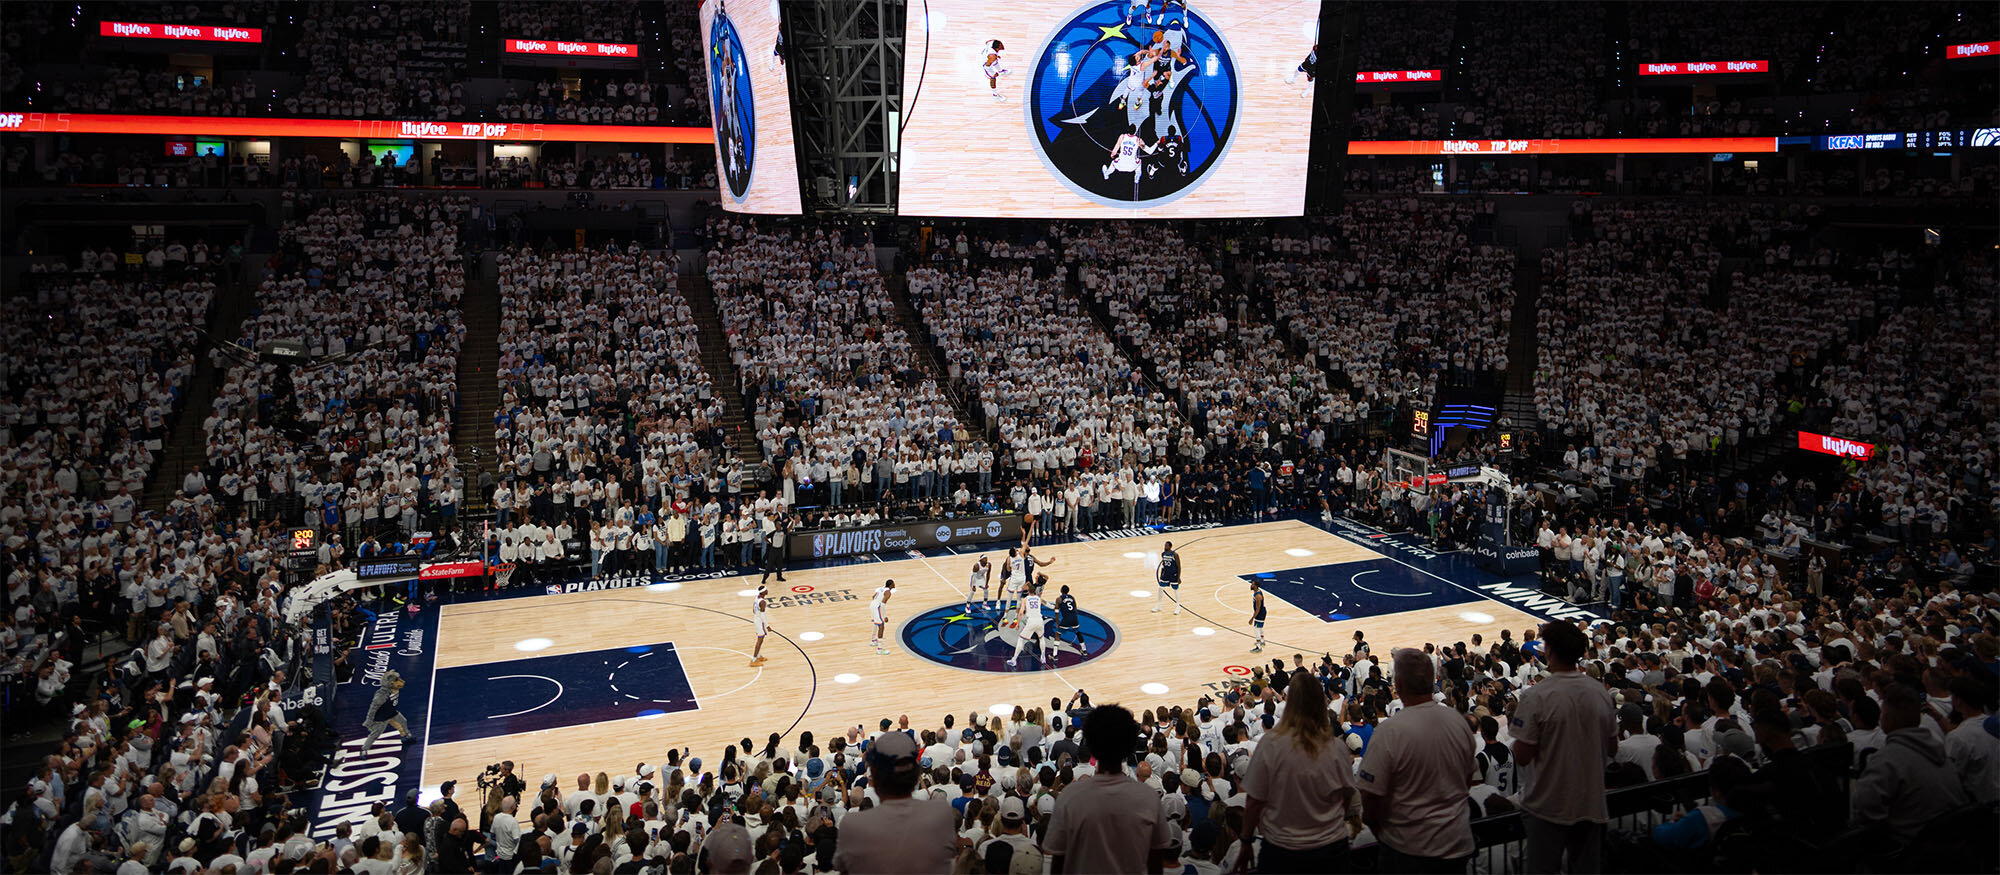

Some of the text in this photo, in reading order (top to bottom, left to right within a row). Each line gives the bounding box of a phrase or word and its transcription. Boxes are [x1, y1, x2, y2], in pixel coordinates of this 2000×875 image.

[462, 124, 480, 136] TIP
[486, 124, 507, 136] OFF
[1490, 141, 1507, 151] TIP
[1511, 141, 1528, 151] OFF
[1828, 135, 1864, 149] KFAN
[1122, 145, 1133, 156] 55
[1169, 147, 1176, 157] 5
[1413, 417, 1428, 434] 24
[1501, 440, 1509, 448] 24
[956, 526, 982, 537] ESPN
[1088, 525, 1160, 541] PLAYOFFS
[295, 538, 310, 549] 24
[825, 529, 882, 555] PLAYOFFS
[884, 536, 916, 548] Google
[1380, 537, 1437, 560] ULTRA
[1505, 549, 1539, 560] coinbase
[366, 563, 398, 575] PLAYOFFS
[663, 569, 739, 582] Google
[565, 576, 651, 594] PLAYOFFS
[766, 589, 852, 603] TARGET
[766, 594, 859, 609] CENTER
[1029, 601, 1039, 609] 55
[1066, 601, 1074, 611] 5
[371, 610, 400, 643] ULTRA
[1497, 771, 1508, 792] 5
